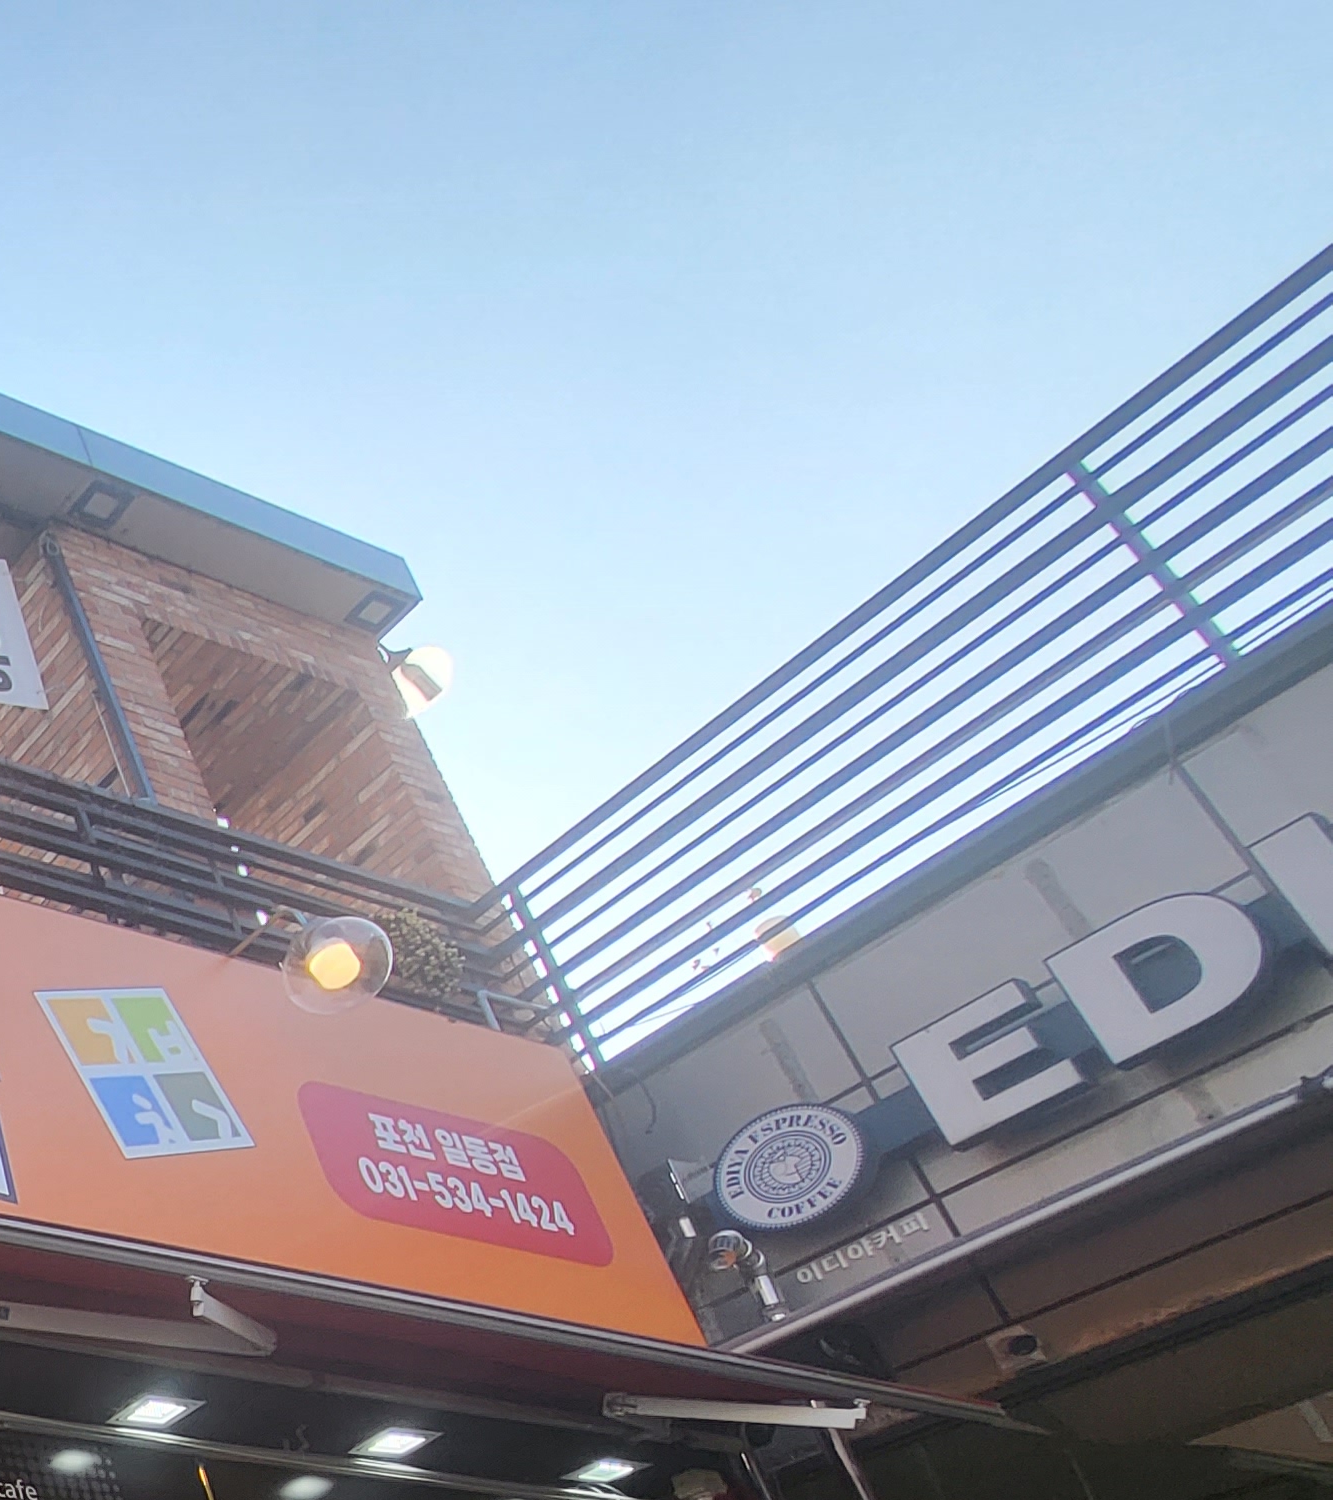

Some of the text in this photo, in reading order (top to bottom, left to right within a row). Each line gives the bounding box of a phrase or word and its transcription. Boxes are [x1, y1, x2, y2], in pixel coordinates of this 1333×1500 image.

[367, 1111, 526, 1182] 포천 일동점
[749, 1114, 847, 1146] ESPRESSO
[358, 1156, 576, 1236] 031-534-1424
[766, 1177, 843, 1220] COFFEE
[796, 1212, 930, 1284] 이디야커피
